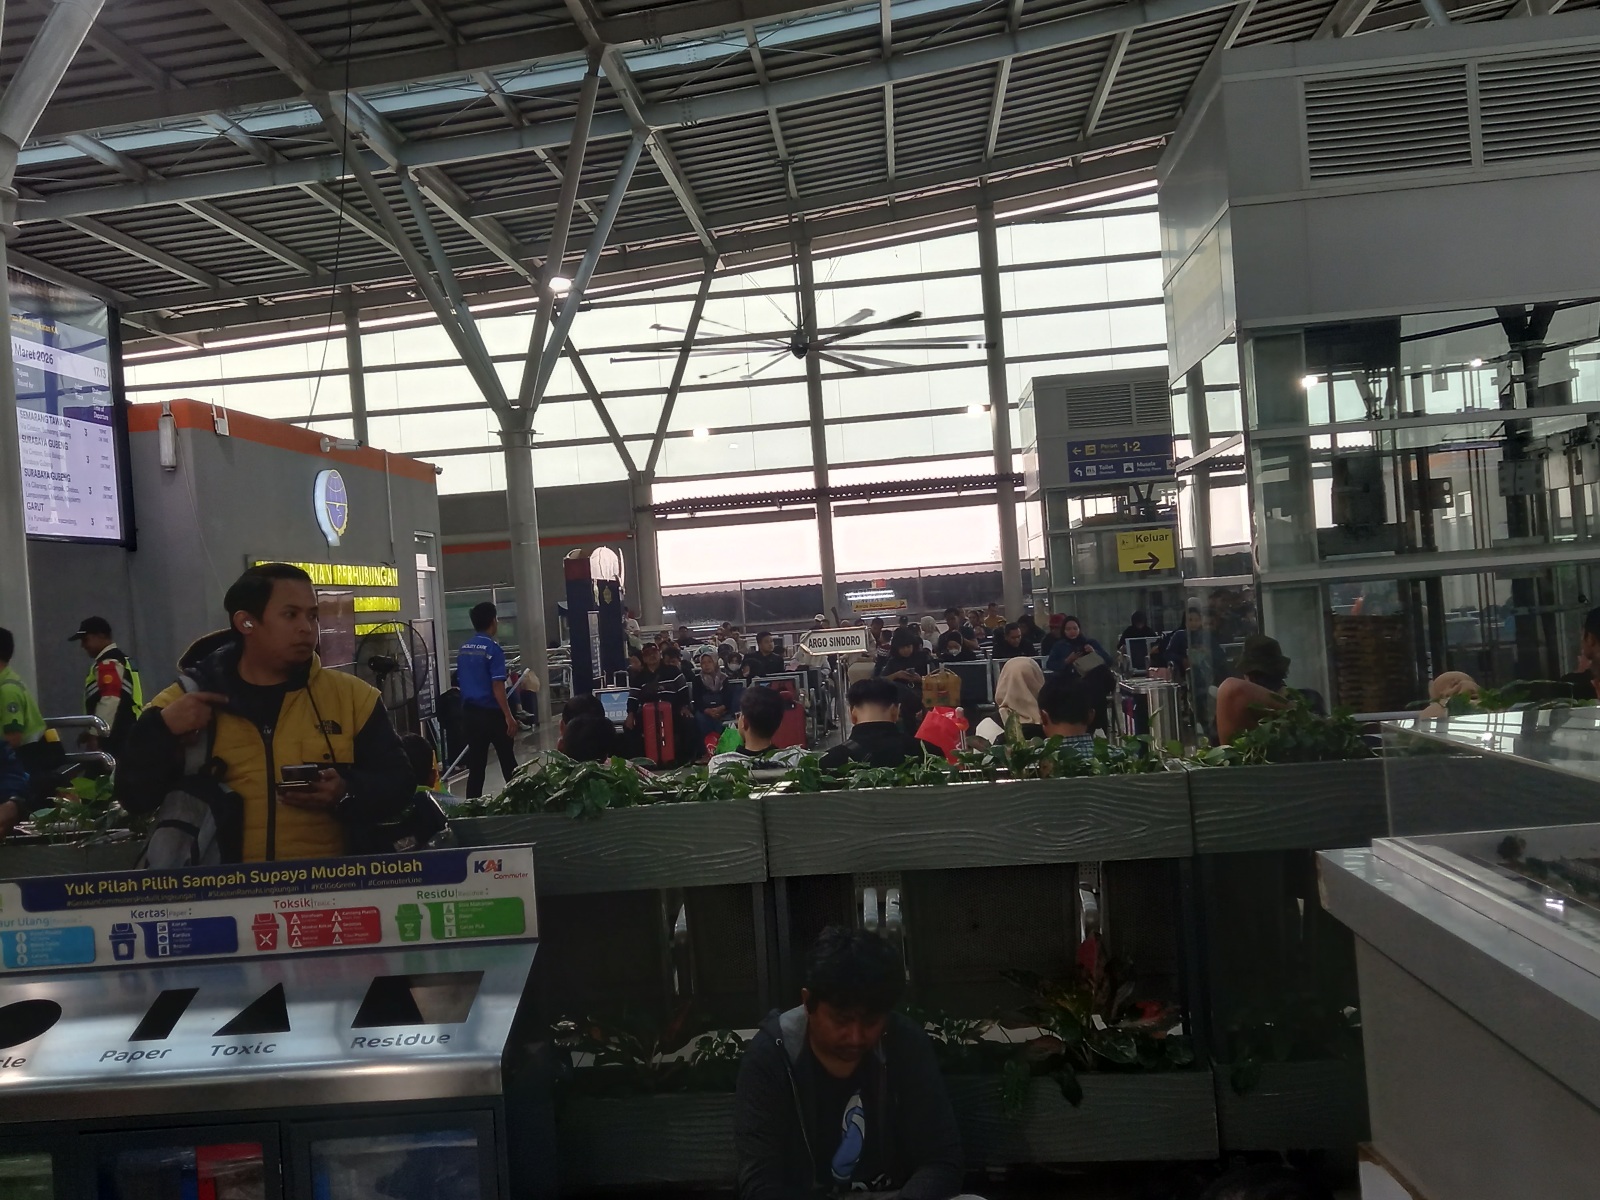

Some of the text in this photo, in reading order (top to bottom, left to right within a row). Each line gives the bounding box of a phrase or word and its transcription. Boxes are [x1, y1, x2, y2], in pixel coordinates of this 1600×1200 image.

[14, 343, 54, 365] Maret 2026
[20, 410, 49, 425] SEMARANG
[48, 415, 71, 429] TAWANG
[83, 428, 88, 437] 3
[21, 434, 69, 451] SURABAYA GUBENG
[24, 467, 71, 483] SURABAYA GUBENG
[88, 486, 93, 495] 3
[26, 501, 44, 512] GARUT
[90, 517, 95, 526] 3
[1135, 533, 1169, 543] Keluar
[808, 635, 861, 649] ARGO SINDORO
[64, 859, 423, 896] Yuk Pilah Pilih Sampah Supaya Mudah Diolah
[493, 872, 528, 880] Commuter
[417, 889, 455, 900] Residu
[273, 898, 311, 909] Toksik
[130, 908, 166, 919] Kertas
[17, 916, 50, 928] Ulang
[350, 1033, 451, 1049] Residue
[210, 1042, 277, 1057] Toxic
[98, 1049, 172, 1063] Paper
